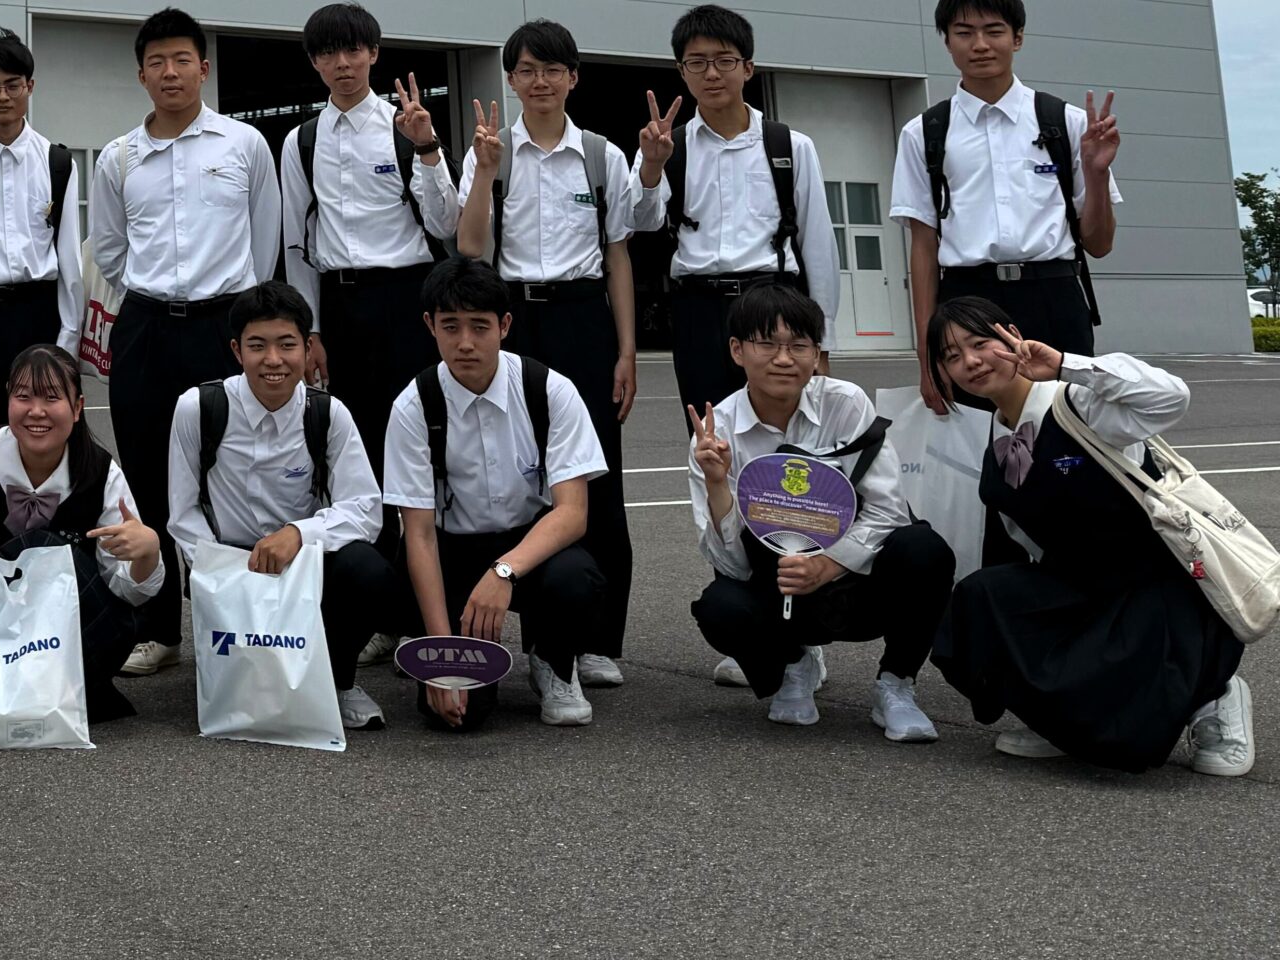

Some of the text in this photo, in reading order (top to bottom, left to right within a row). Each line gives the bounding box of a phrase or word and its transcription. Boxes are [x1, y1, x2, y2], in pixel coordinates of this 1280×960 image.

[82, 343, 102, 365] VINTAE
[3, 637, 61, 665] TADANO
[245, 633, 306, 649] TADANO
